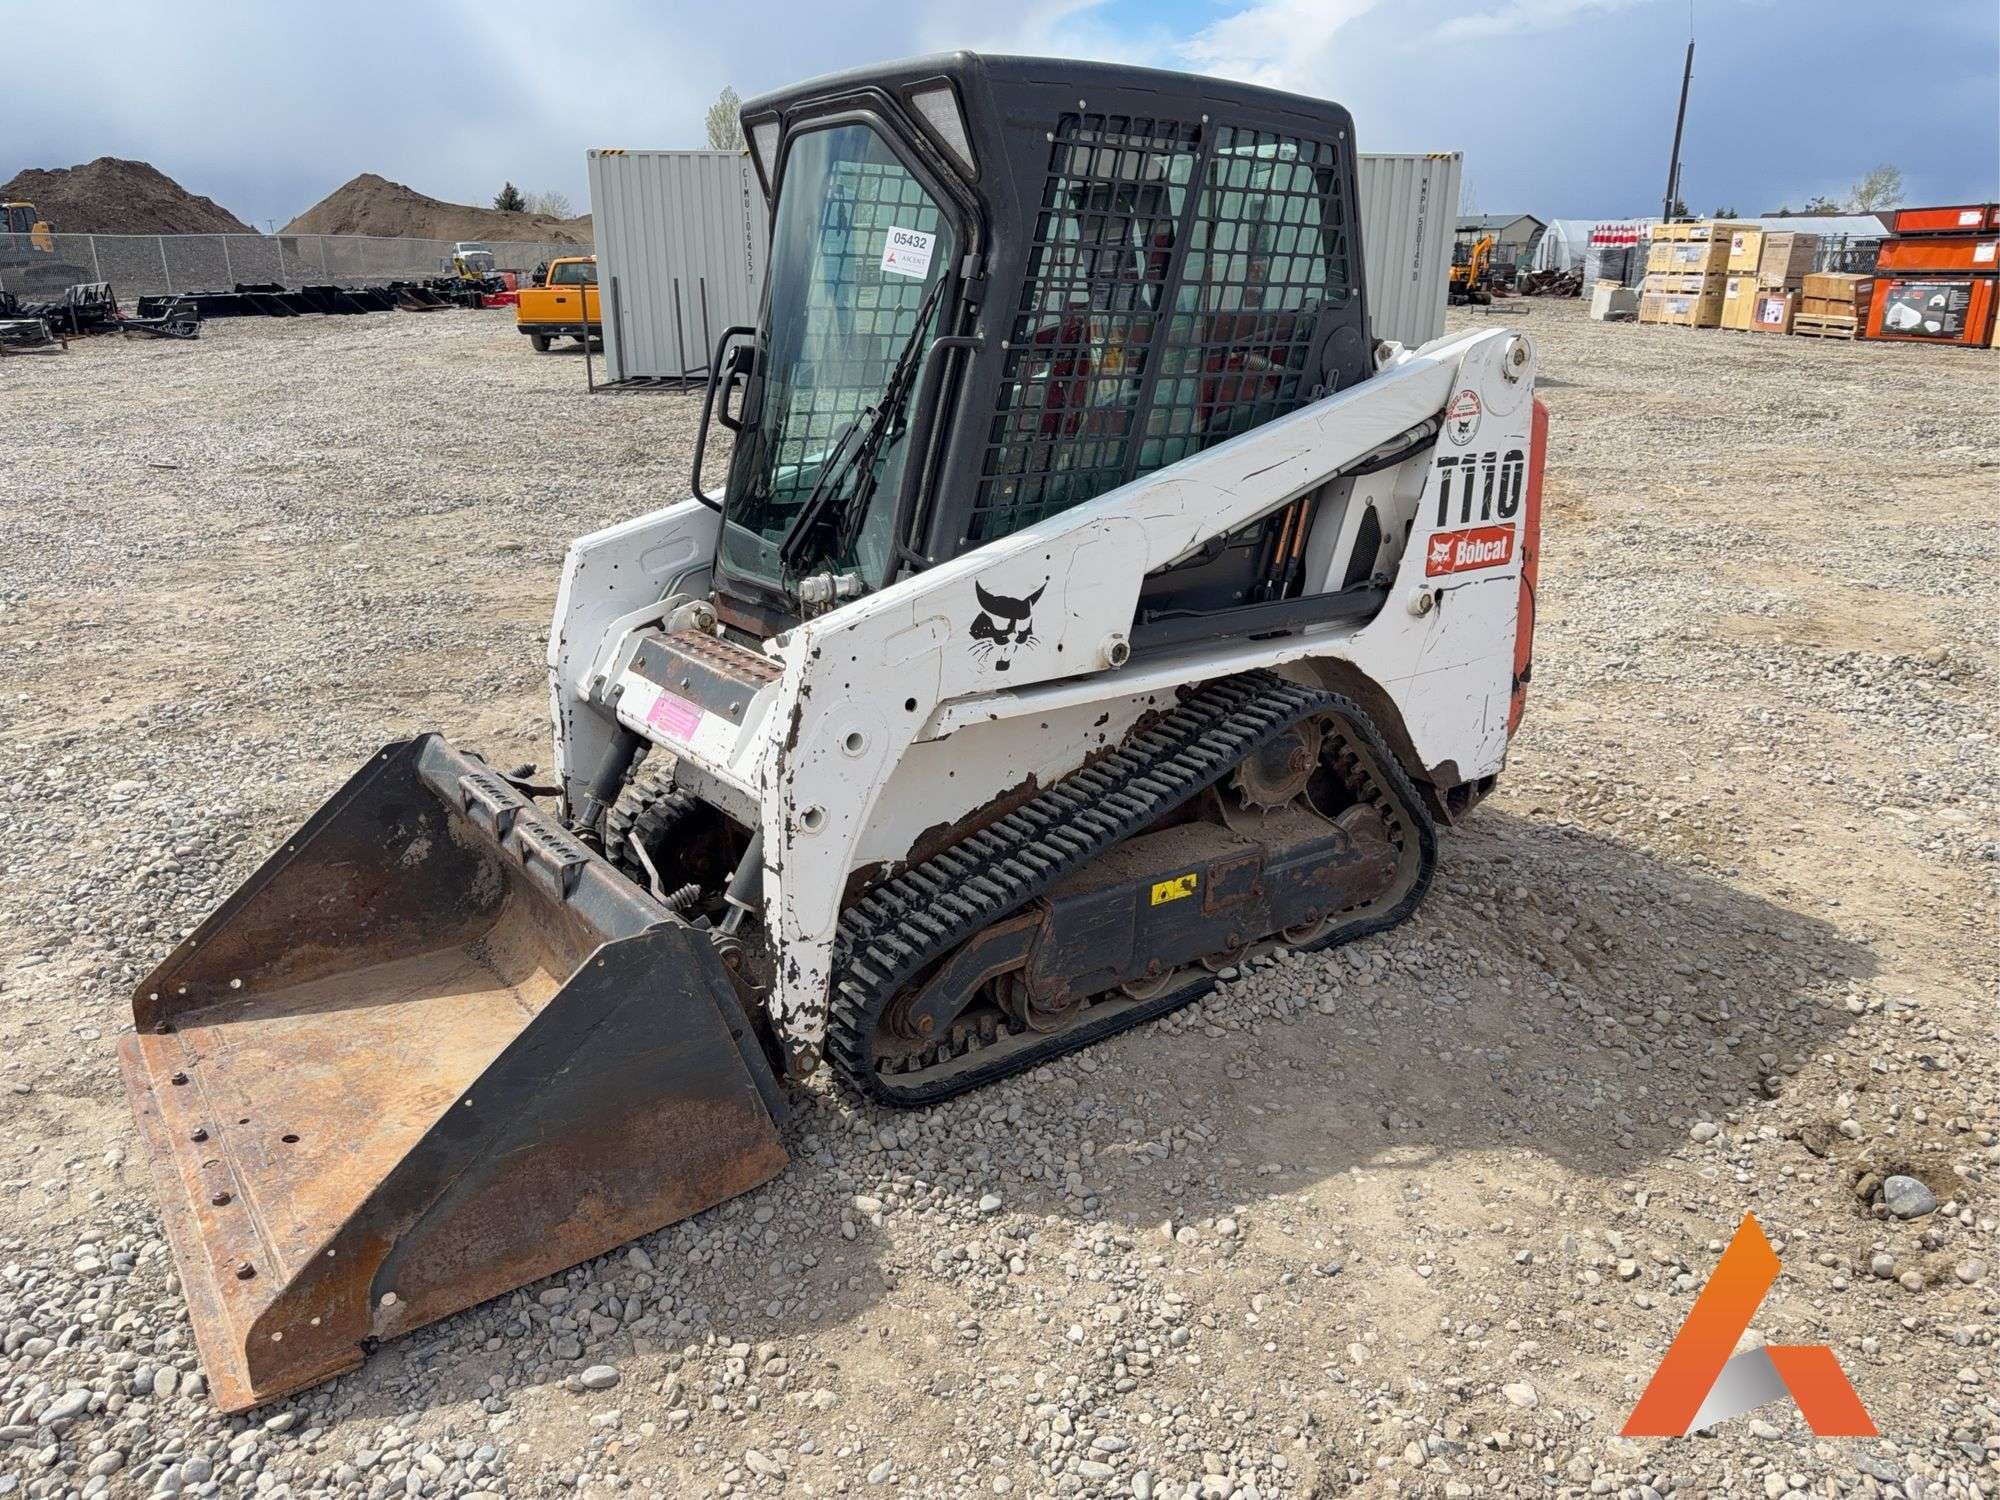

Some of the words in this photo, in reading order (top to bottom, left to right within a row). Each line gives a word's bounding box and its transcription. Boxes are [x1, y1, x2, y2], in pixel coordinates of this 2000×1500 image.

[742, 168, 751, 209] CIMU
[745, 211, 754, 272] 106455
[893, 231, 928, 250] 05432
[1437, 449, 1525, 528] T110
[1455, 535, 1507, 566] Bobcat
